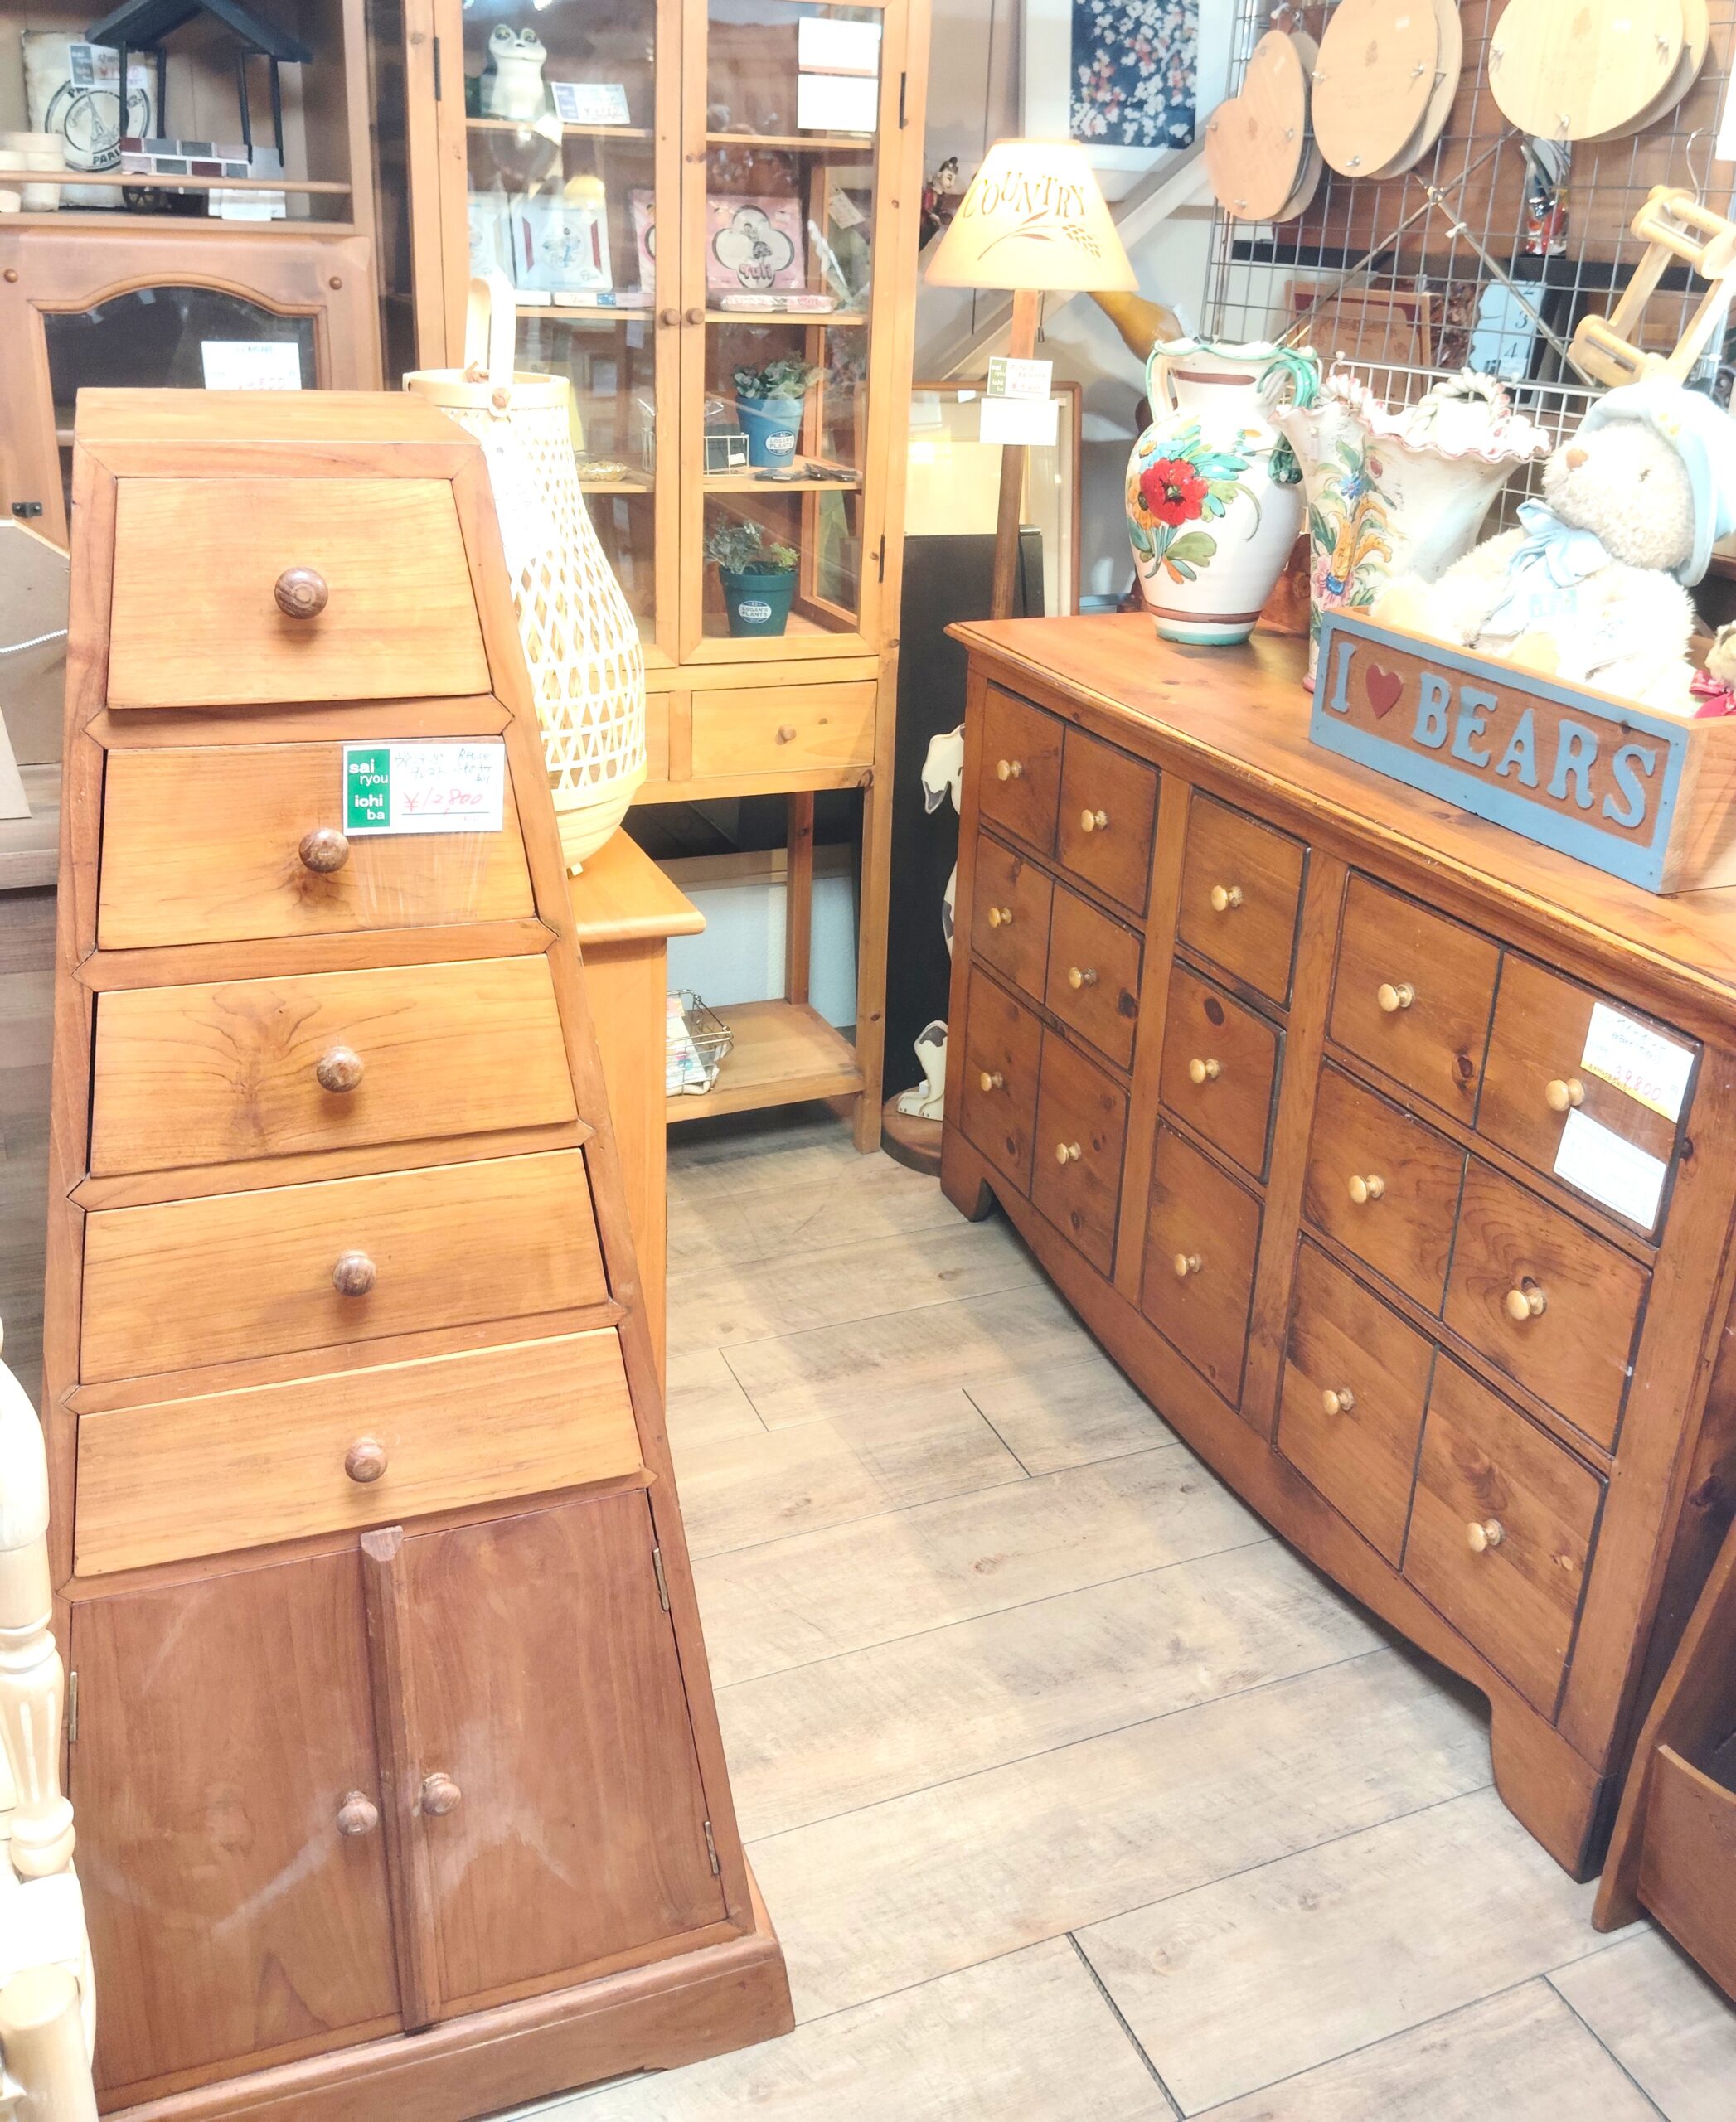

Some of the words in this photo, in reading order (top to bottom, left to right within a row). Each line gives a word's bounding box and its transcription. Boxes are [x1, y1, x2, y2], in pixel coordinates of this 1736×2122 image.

[93, 147, 122, 165] PARI
[963, 170, 1086, 219] COUNTRY
[1515, 311, 1528, 328] 3
[1504, 342, 1518, 358] 4
[1330, 642, 1357, 714] I
[1412, 671, 1656, 828] BEARS
[349, 758, 375, 774] sai
[360, 774, 389, 787] ryou
[354, 793, 384, 808] ichi
[366, 809, 386, 821] ba
